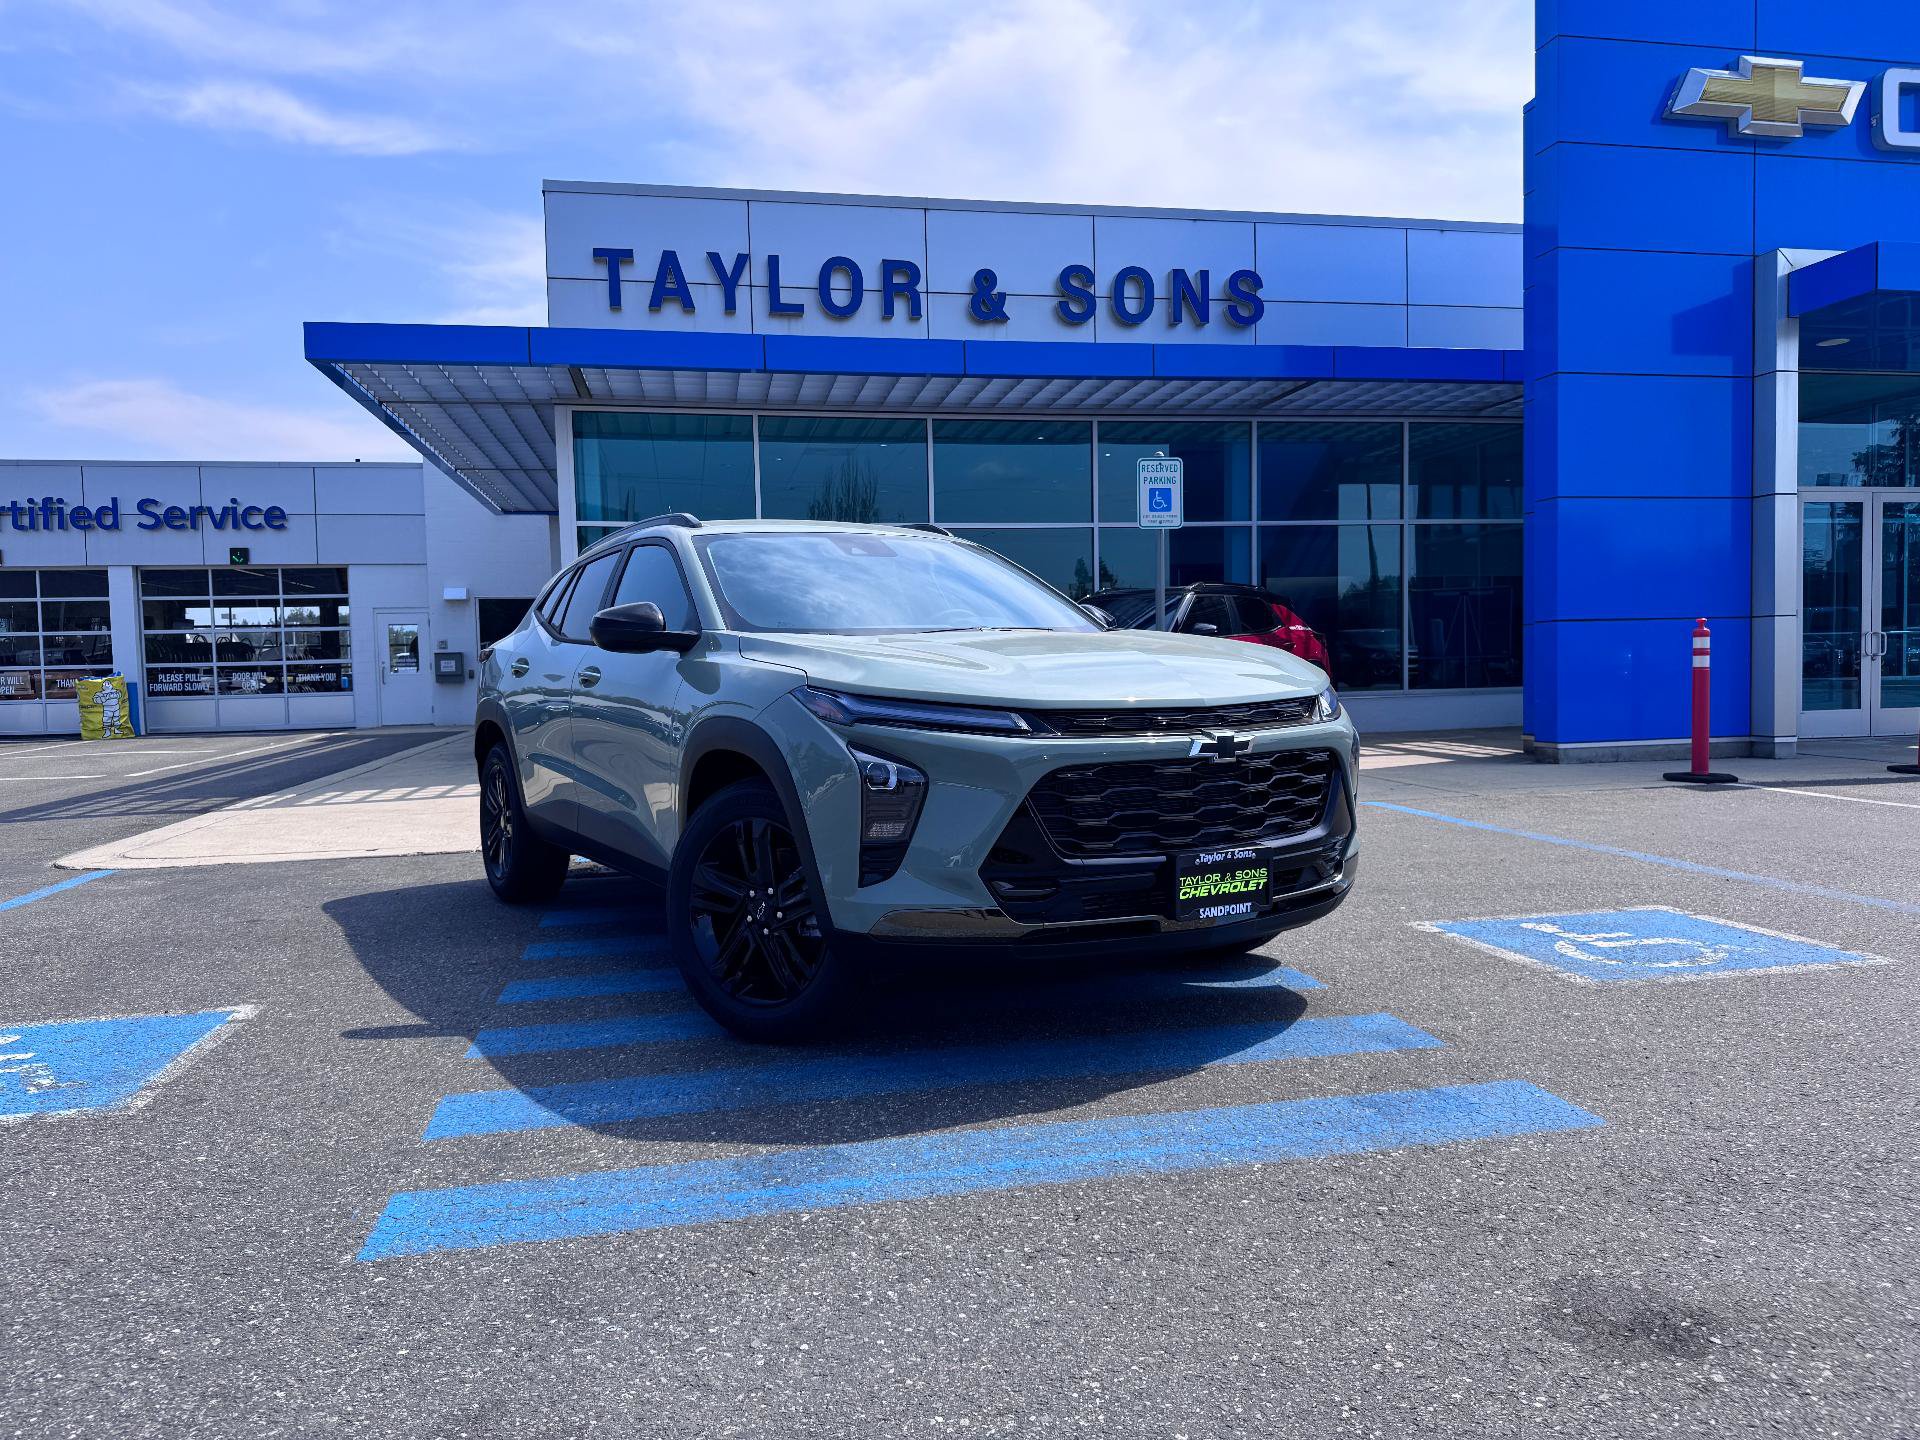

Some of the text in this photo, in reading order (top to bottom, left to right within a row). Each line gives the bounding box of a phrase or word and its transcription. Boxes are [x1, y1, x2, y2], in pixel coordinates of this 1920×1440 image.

[593, 247, 1265, 327] TAYLOR & SONS
[1141, 464, 1179, 473] RESERVED
[1143, 476, 1177, 485] PARKING
[136, 497, 288, 531] Service
[6, 676, 25, 685] WILL
[158, 673, 202, 683] PLEASE PULL
[232, 672, 250, 681] DOOR
[298, 673, 337, 682] THANK YOU!
[56, 679, 77, 688] THAN
[149, 682, 211, 692] FORWARD SLOWLY
[0, 686, 15, 695] PEN
[1200, 852, 1226, 865] Taylor
[1233, 849, 1252, 860] Sons
[1179, 868, 1268, 887] TAYLOR & SONS
[1179, 879, 1268, 900] CHEVROLET
[1199, 902, 1252, 919] SANDPOINT
